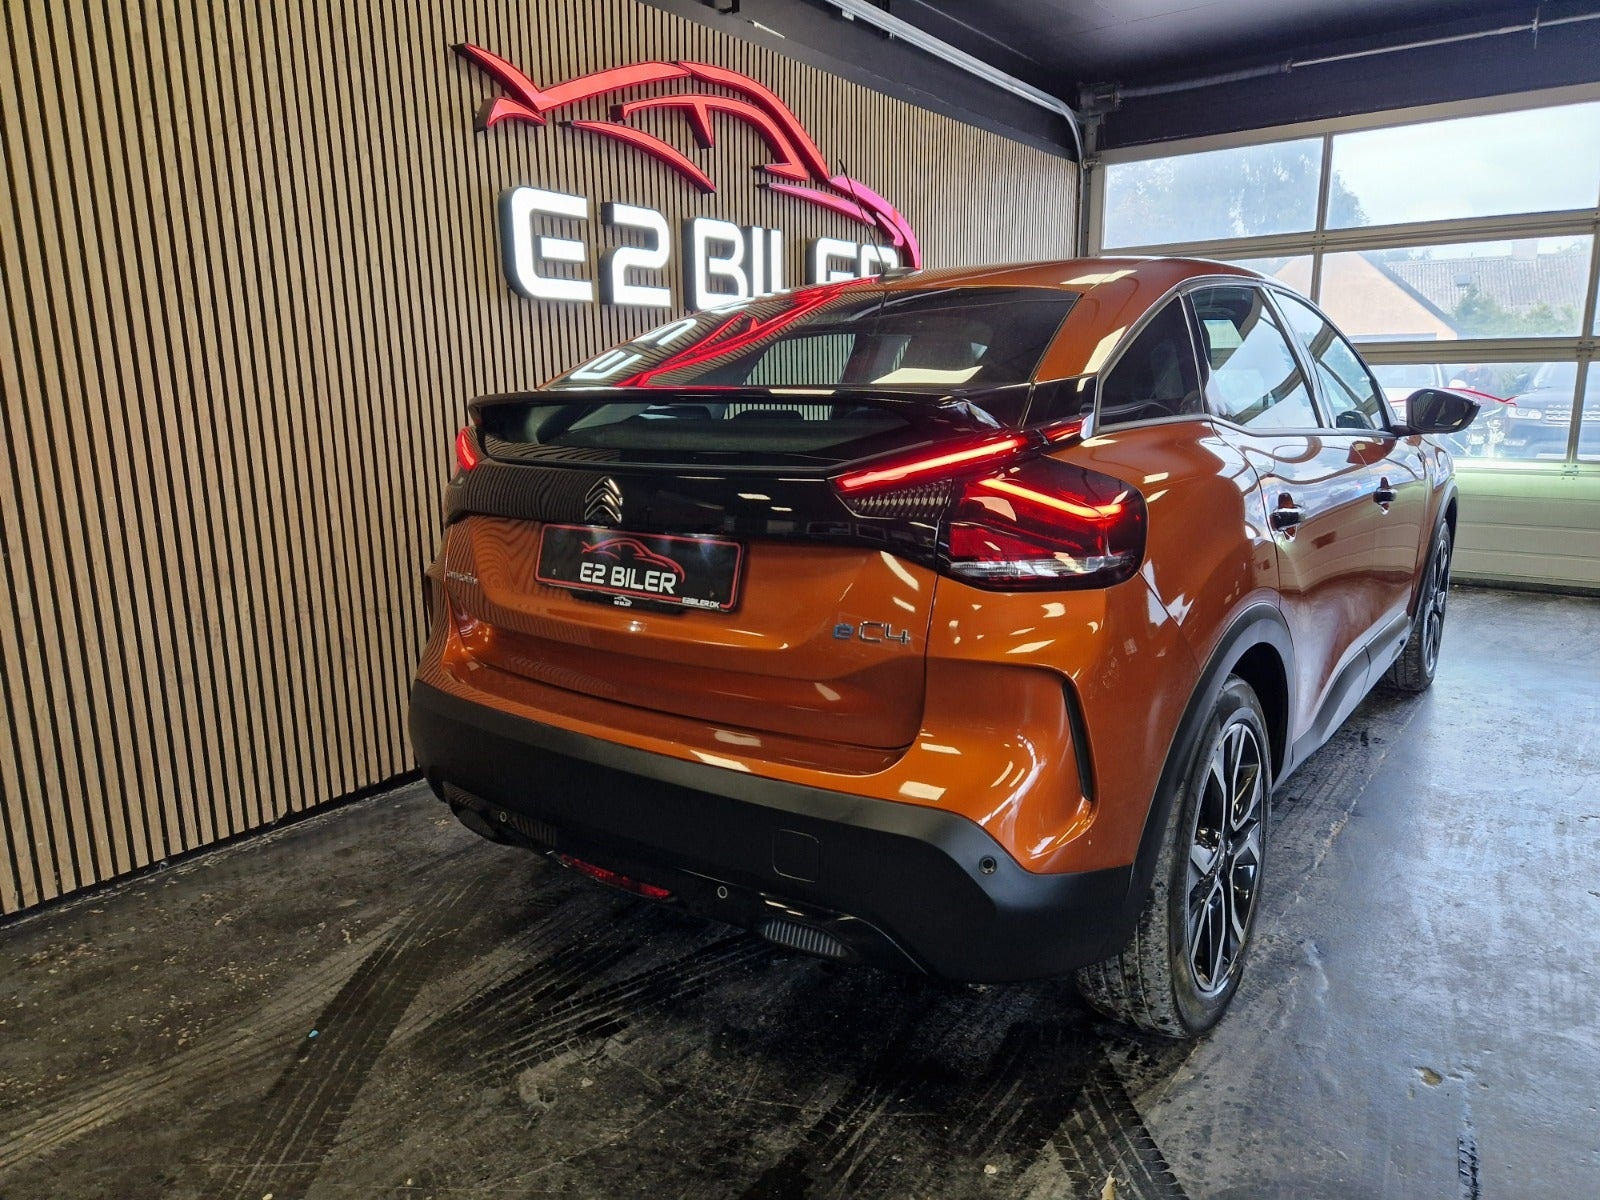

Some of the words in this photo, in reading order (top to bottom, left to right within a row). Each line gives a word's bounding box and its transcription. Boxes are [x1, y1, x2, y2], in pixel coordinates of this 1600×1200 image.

[504, 186, 672, 307] E2
[580, 561, 606, 584] E2
[610, 565, 677, 594] BILER
